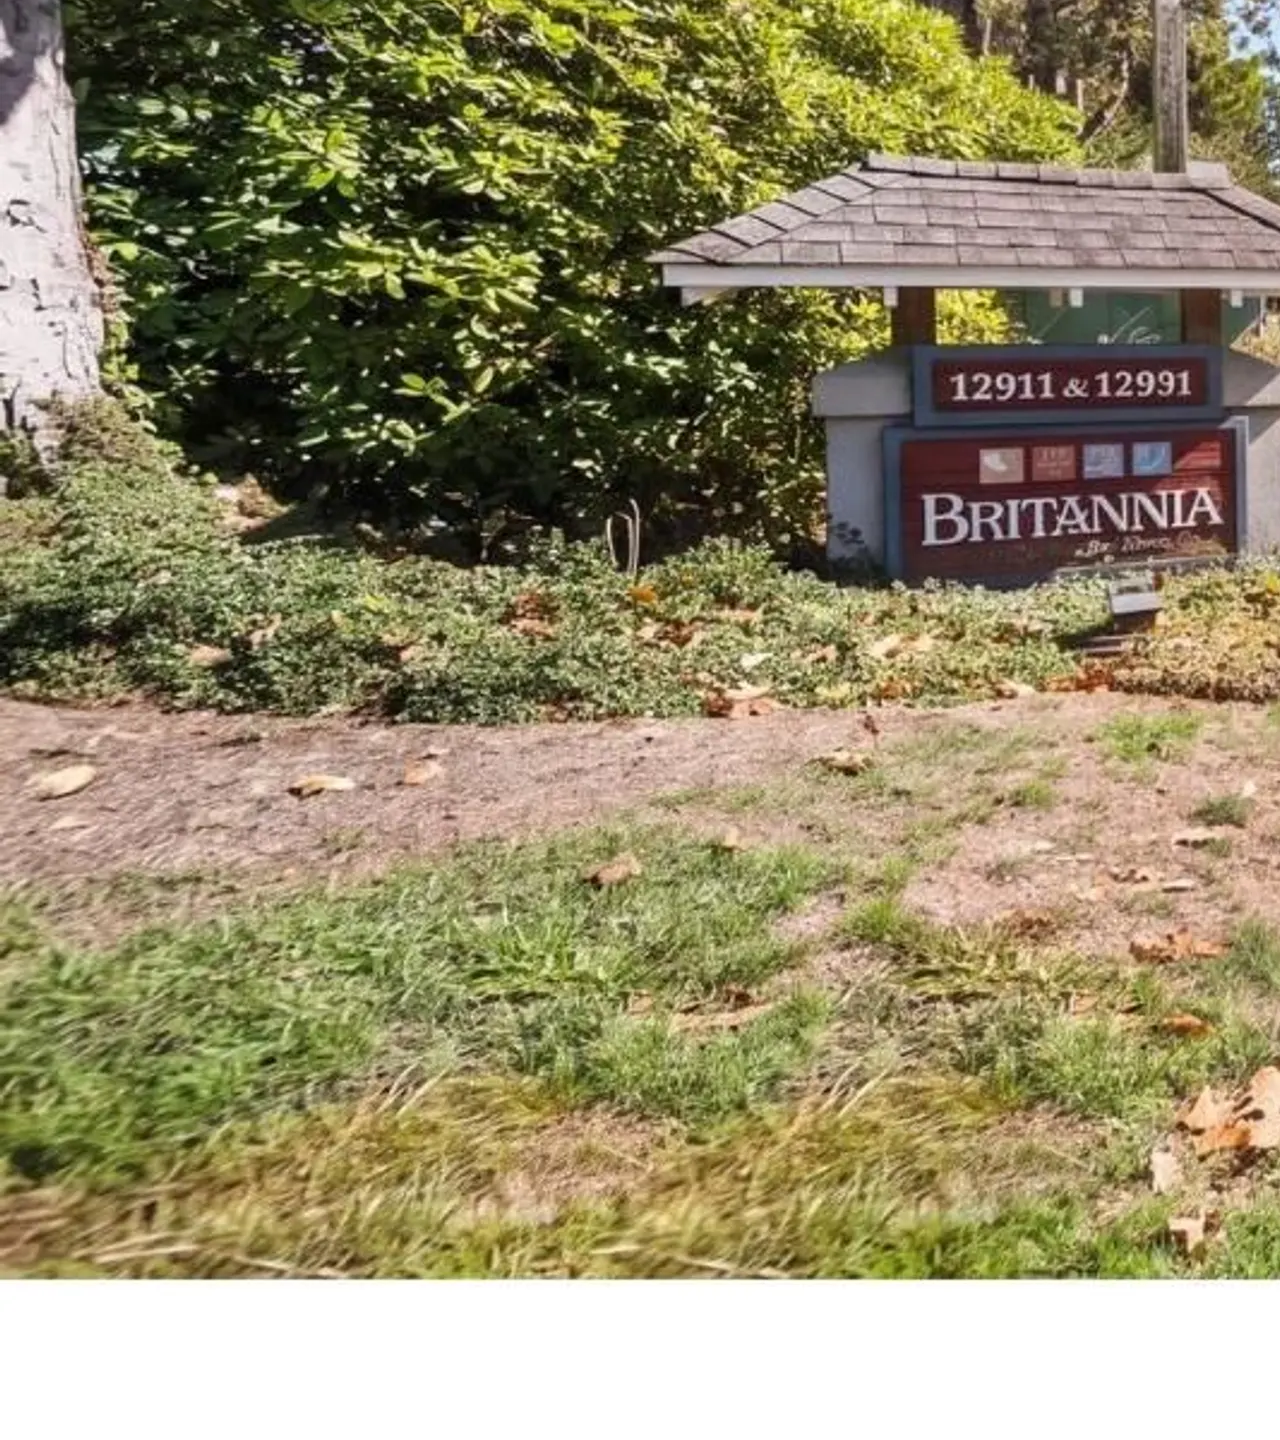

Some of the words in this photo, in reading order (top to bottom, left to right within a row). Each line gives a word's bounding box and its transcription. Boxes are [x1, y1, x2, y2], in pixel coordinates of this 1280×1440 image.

[949, 371, 1055, 401] 12911
[1062, 377, 1089, 399] &
[1095, 369, 1192, 397] 12991
[921, 487, 1224, 547] BRITANNIA
